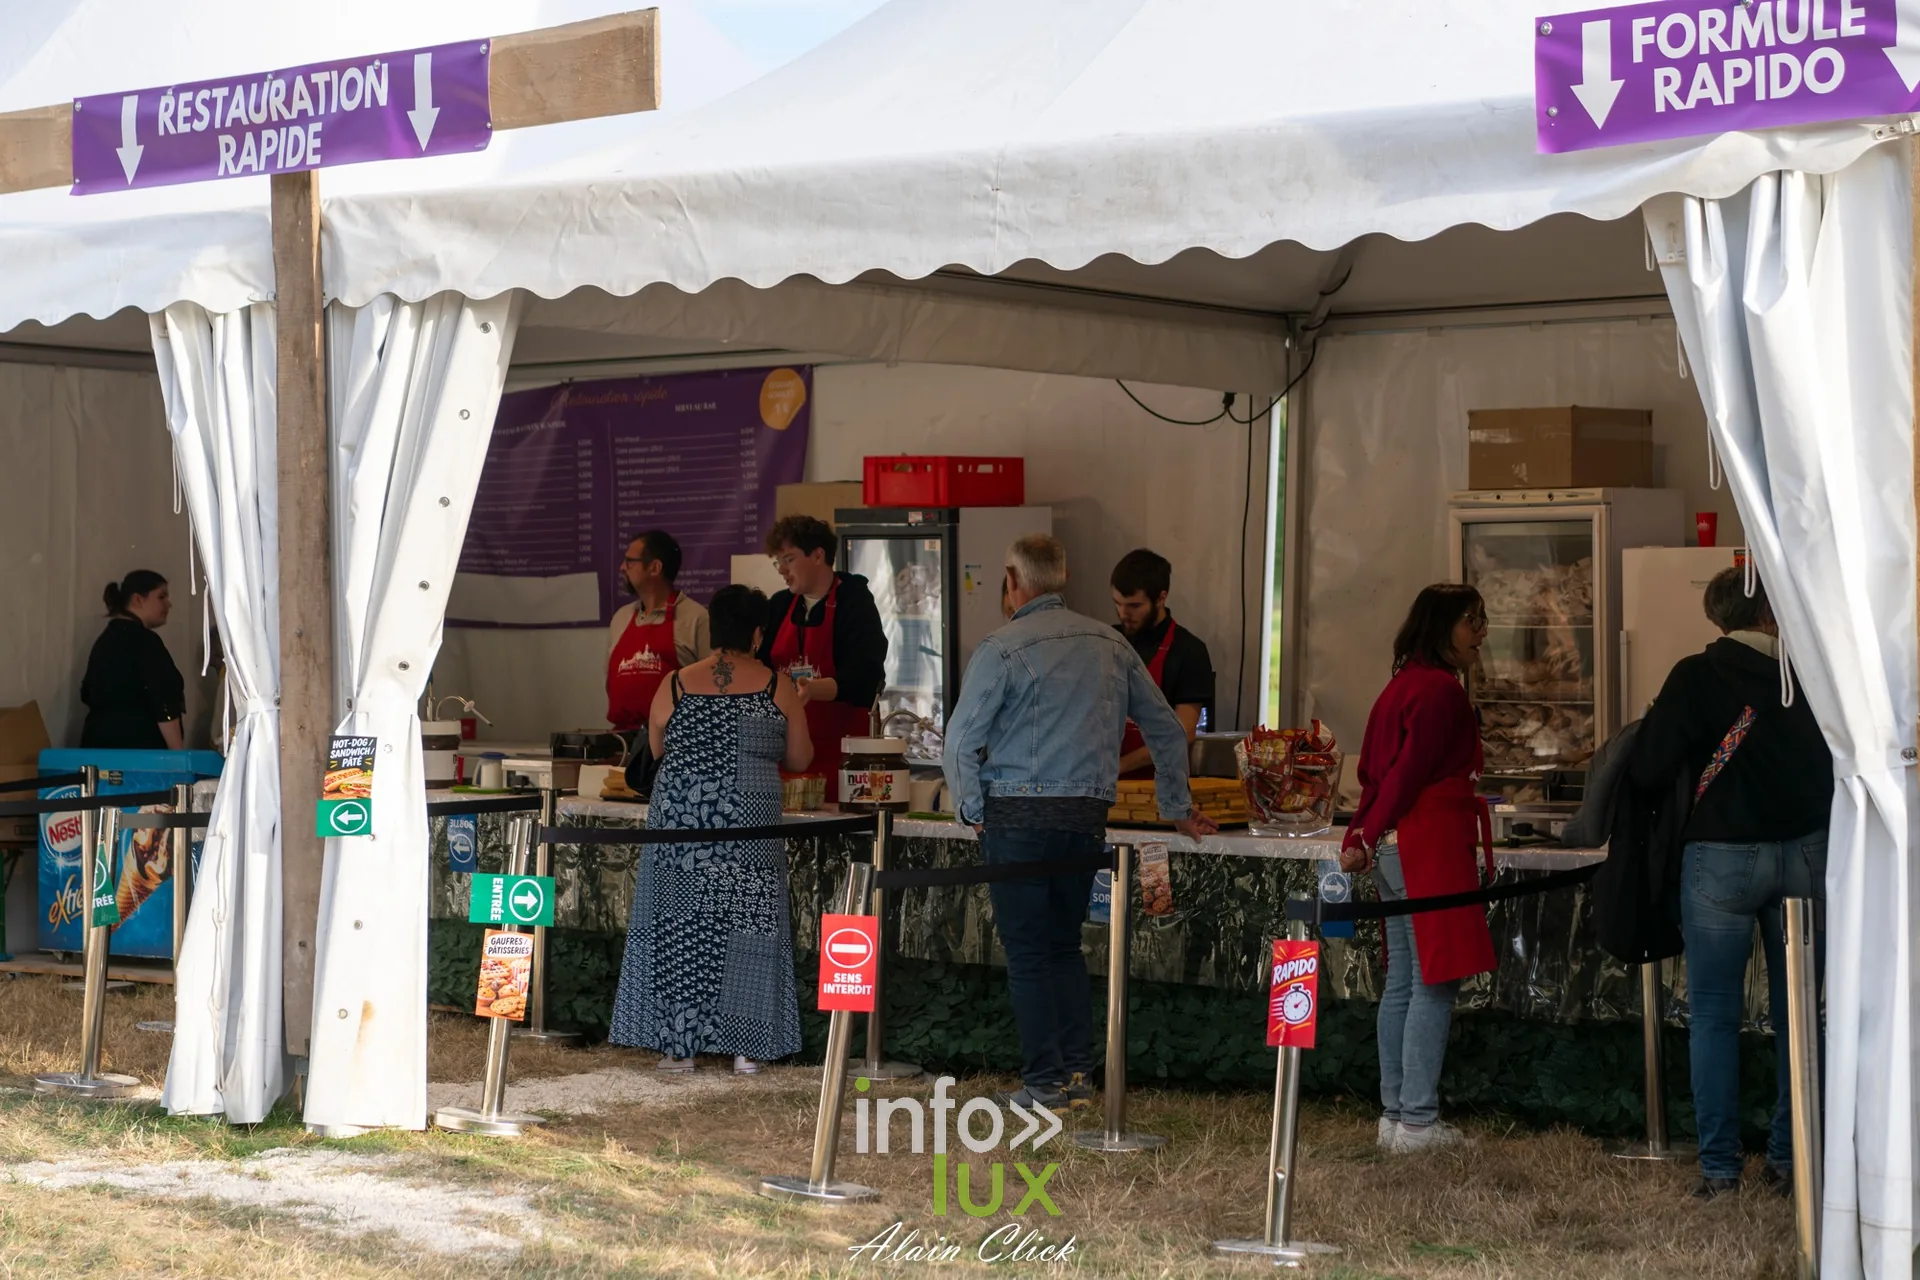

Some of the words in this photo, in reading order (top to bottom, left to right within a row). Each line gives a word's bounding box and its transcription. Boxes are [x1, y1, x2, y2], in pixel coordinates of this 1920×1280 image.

[1632, 0, 1866, 63] FORMULE
[1654, 46, 1846, 113] RAPIDO
[157, 62, 389, 137] RESTAURATION
[217, 122, 322, 176] RAPIDE
[330, 747, 371, 759] SANDWICH
[332, 738, 368, 749] HOT-DOG
[490, 877, 504, 921] ENTRÉE
[490, 937, 523, 946] GAUFRES
[833, 973, 862, 983] SENS
[1273, 957, 1317, 985] RAPIDO
[823, 983, 872, 995] INTERDIT
